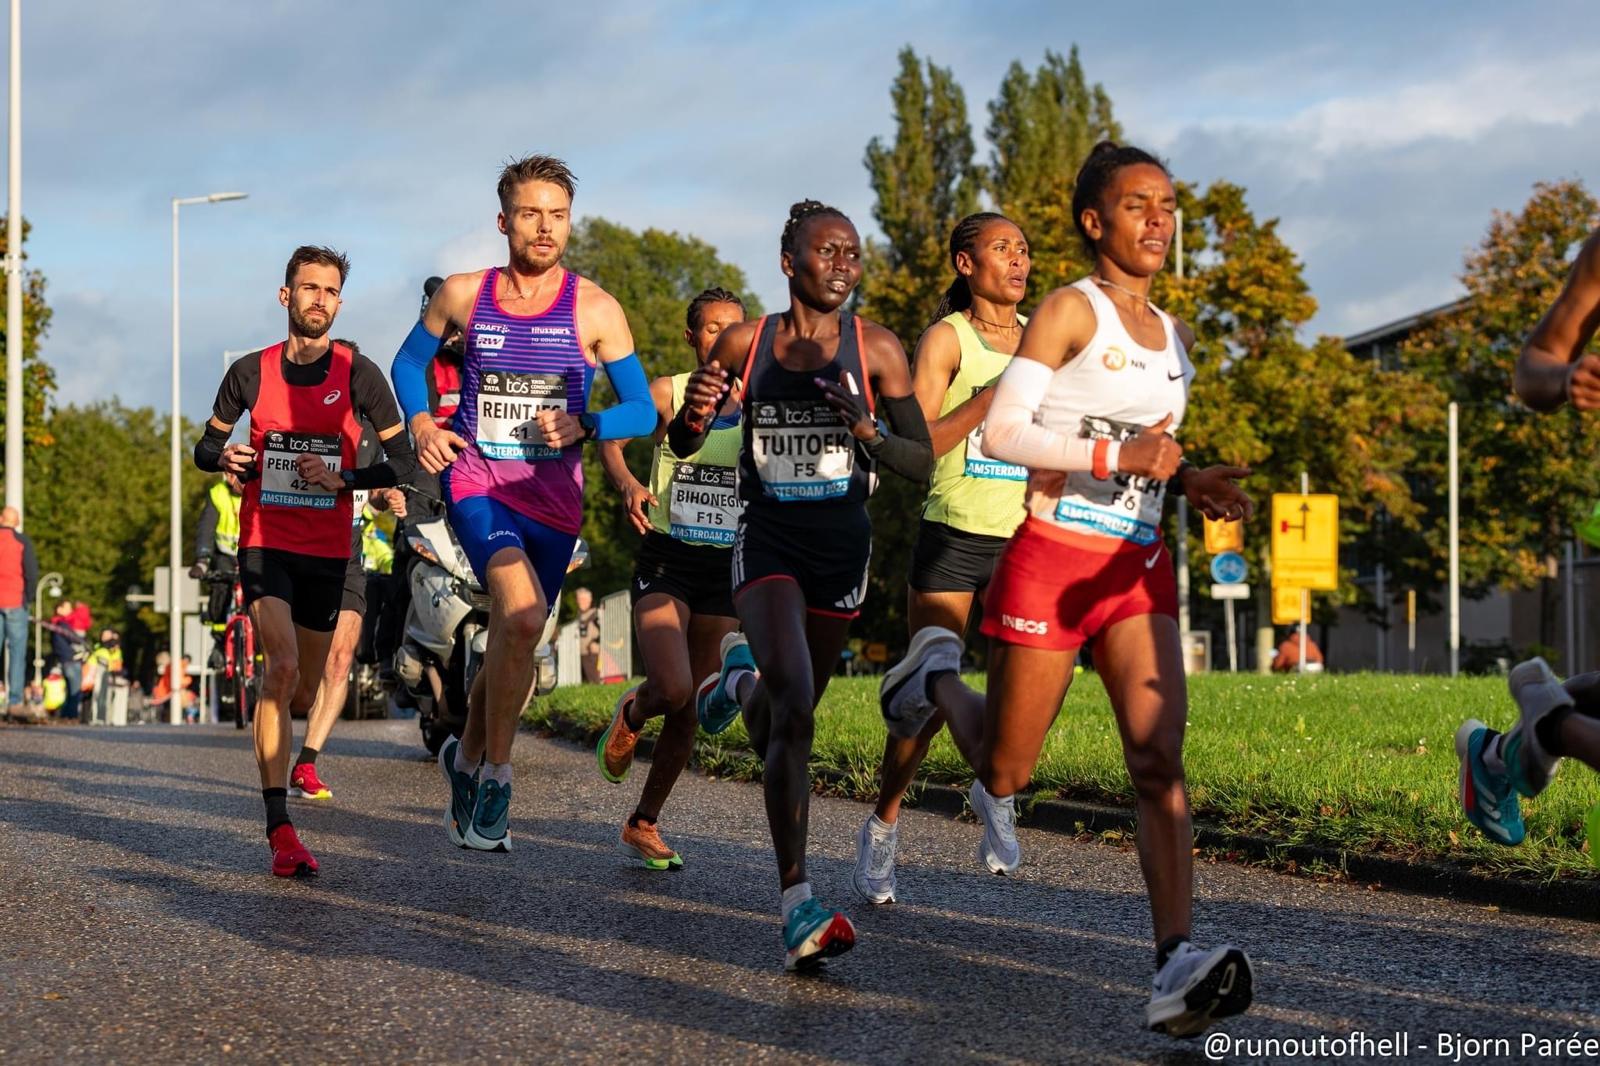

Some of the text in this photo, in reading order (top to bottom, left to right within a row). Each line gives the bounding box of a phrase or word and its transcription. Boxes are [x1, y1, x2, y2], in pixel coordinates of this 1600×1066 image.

[474, 323, 502, 332] CRAFT
[483, 385, 500, 393] TATA
[506, 378, 529, 394] tcs
[757, 417, 779, 425] TATA
[785, 407, 812, 424] tcs
[508, 426, 528, 440] 41
[289, 437, 309, 451] tcs
[758, 432, 849, 456] TUITOEK
[677, 473, 695, 481] TATA
[700, 469, 721, 484] tcs
[793, 462, 816, 478] F5
[290, 479, 309, 491] 42
[261, 493, 335, 507] AMSTERDAM 2023
[696, 511, 724, 525] F15
[670, 526, 722, 541] AMSTERDAM
[1002, 614, 1049, 635] INEOS
